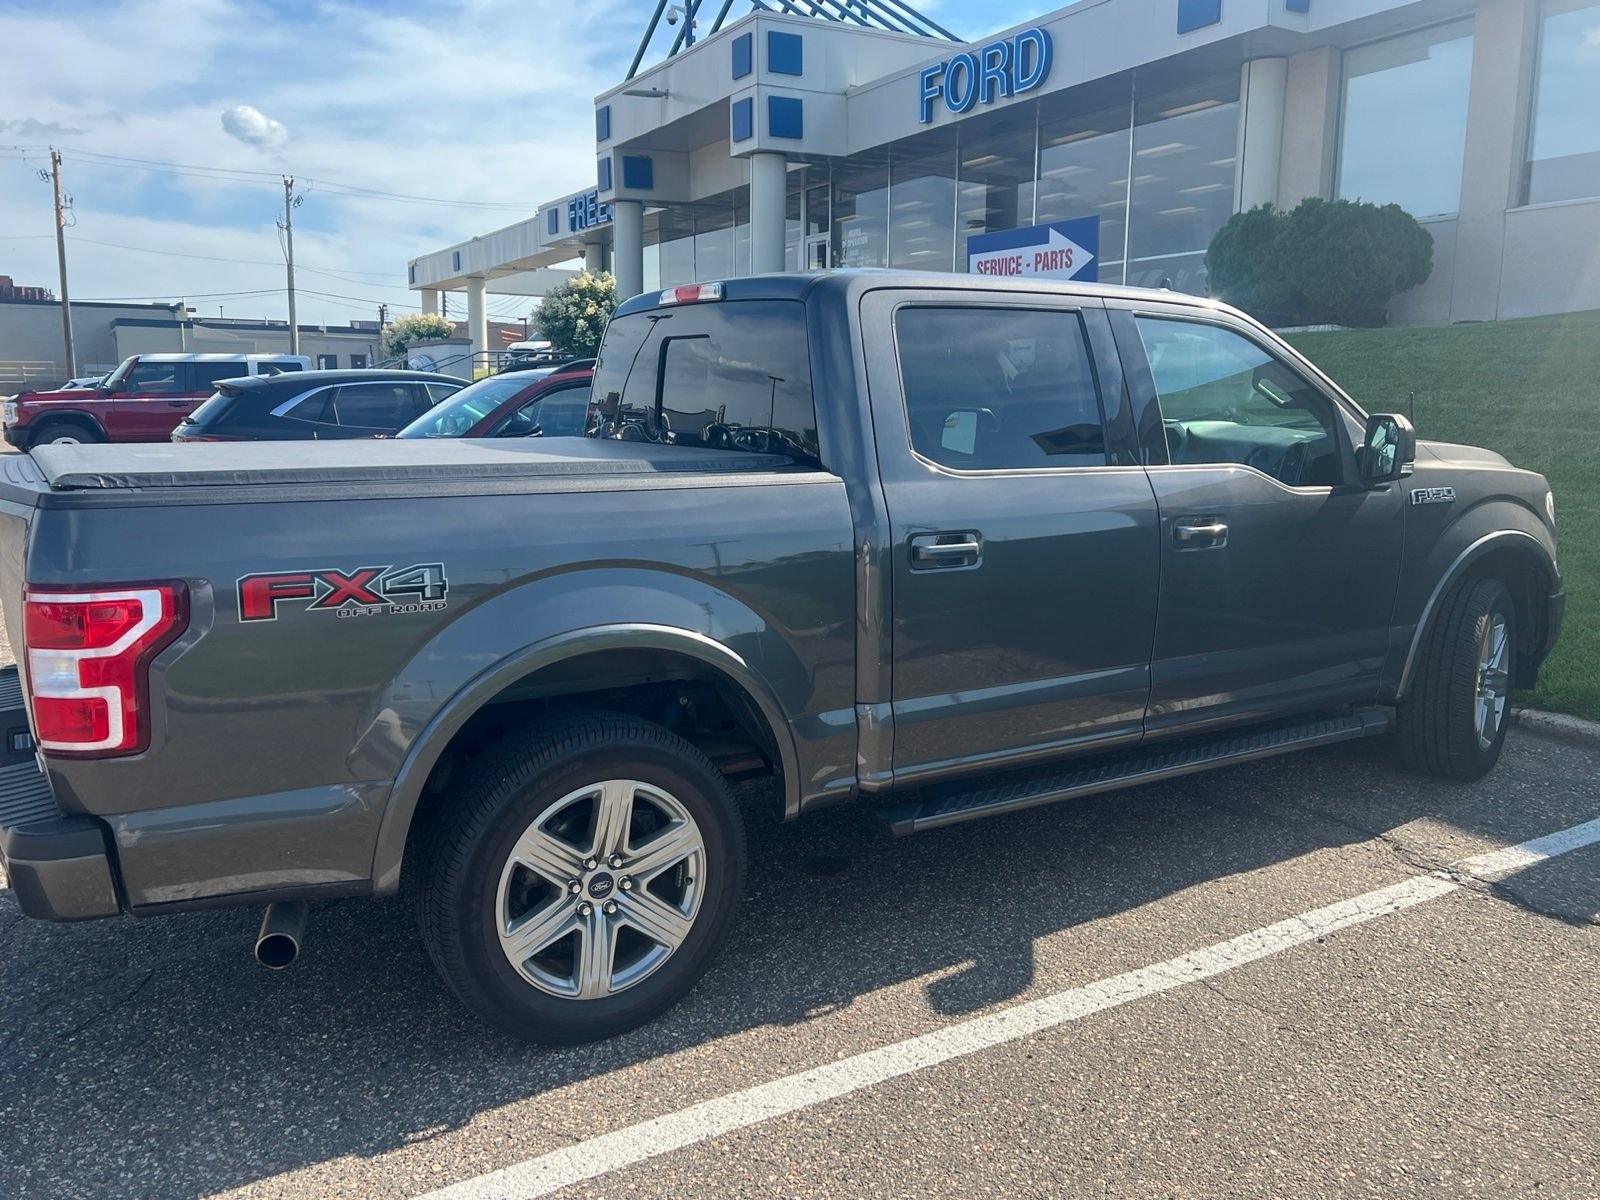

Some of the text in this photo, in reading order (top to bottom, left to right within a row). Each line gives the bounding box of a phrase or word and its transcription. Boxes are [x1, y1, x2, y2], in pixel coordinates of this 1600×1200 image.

[919, 27, 1053, 124] FORD
[568, 190, 614, 232] FREE
[977, 255, 1022, 276] SERVICE
[1034, 248, 1073, 272] PARTS
[235, 561, 449, 623] FX4
[336, 602, 448, 618] OFF ROAD
[593, 881, 610, 891] Ford
